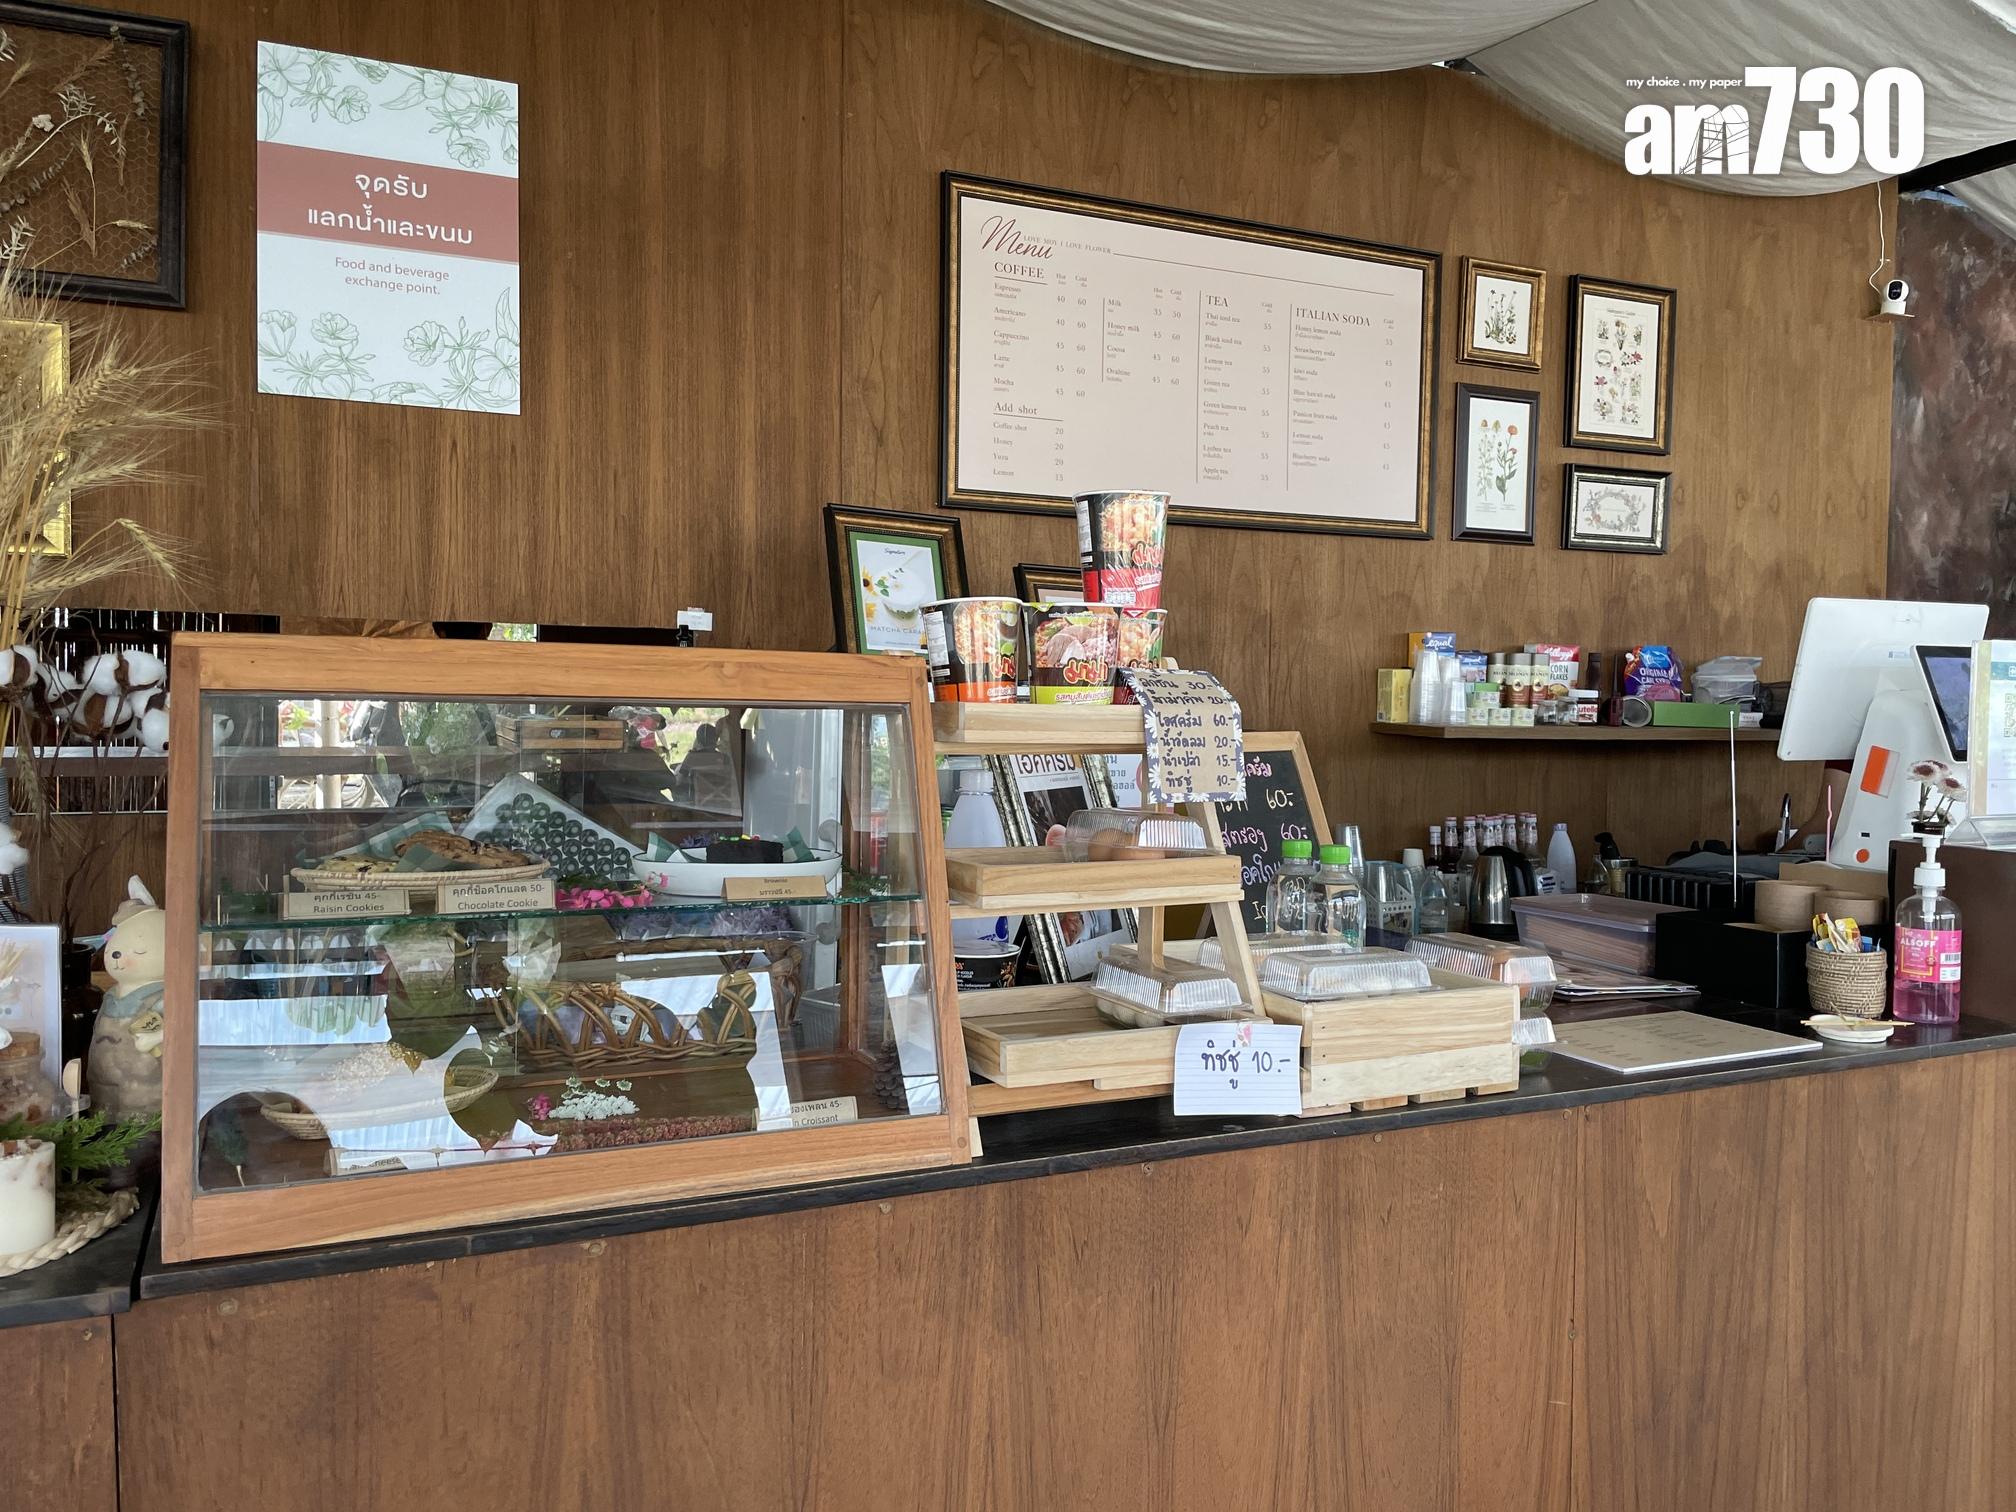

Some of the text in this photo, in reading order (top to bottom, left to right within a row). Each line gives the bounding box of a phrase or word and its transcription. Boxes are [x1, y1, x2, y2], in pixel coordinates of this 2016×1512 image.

[355, 173, 428, 199] จุดรับ
[307, 203, 473, 245] แลกน้ำและขนม
[980, 215, 1053, 260] Menu
[335, 256, 450, 282] Food and beverage
[994, 261, 1045, 280] COFFEE
[345, 275, 441, 296] exchange point.
[994, 282, 1022, 293] Espresso
[1077, 298, 1087, 307] 60
[1205, 295, 1229, 308] TEA
[1107, 298, 1121, 307] Milk
[993, 306, 1027, 317] Americano
[1077, 321, 1087, 330] 60
[1206, 312, 1219, 321] Thai
[1296, 307, 1371, 328] ITALIAN SODA
[1107, 321, 1127, 331] Honey
[1127, 324, 1140, 333] milk
[993, 329, 1086, 353] Cappuccino 45 60
[1056, 364, 1065, 373] 45
[1076, 367, 1086, 376] 60
[993, 376, 1015, 387] Mocha
[994, 401, 1038, 416] Add shot
[993, 421, 1064, 436] Coffee shot 20
[993, 437, 1064, 451] Honey 20
[870, 626, 901, 635] MATCHA
[1425, 636, 1454, 651] equal
[1550, 664, 1569, 674] CORN
[1549, 673, 1569, 681] FLAKES
[1212, 713, 1234, 727] 60.-
[1214, 735, 1237, 749] 20.-
[1215, 754, 1238, 768] 15.-
[1216, 775, 1237, 787] 10.-
[313, 903, 385, 914] Raisin Cookies
[457, 899, 539, 911] Chocolate Cookie
[1900, 937, 1937, 948] ALSOFF
[1251, 1050, 1291, 1074] 10.-
[801, 1113, 839, 1127] Croissant
